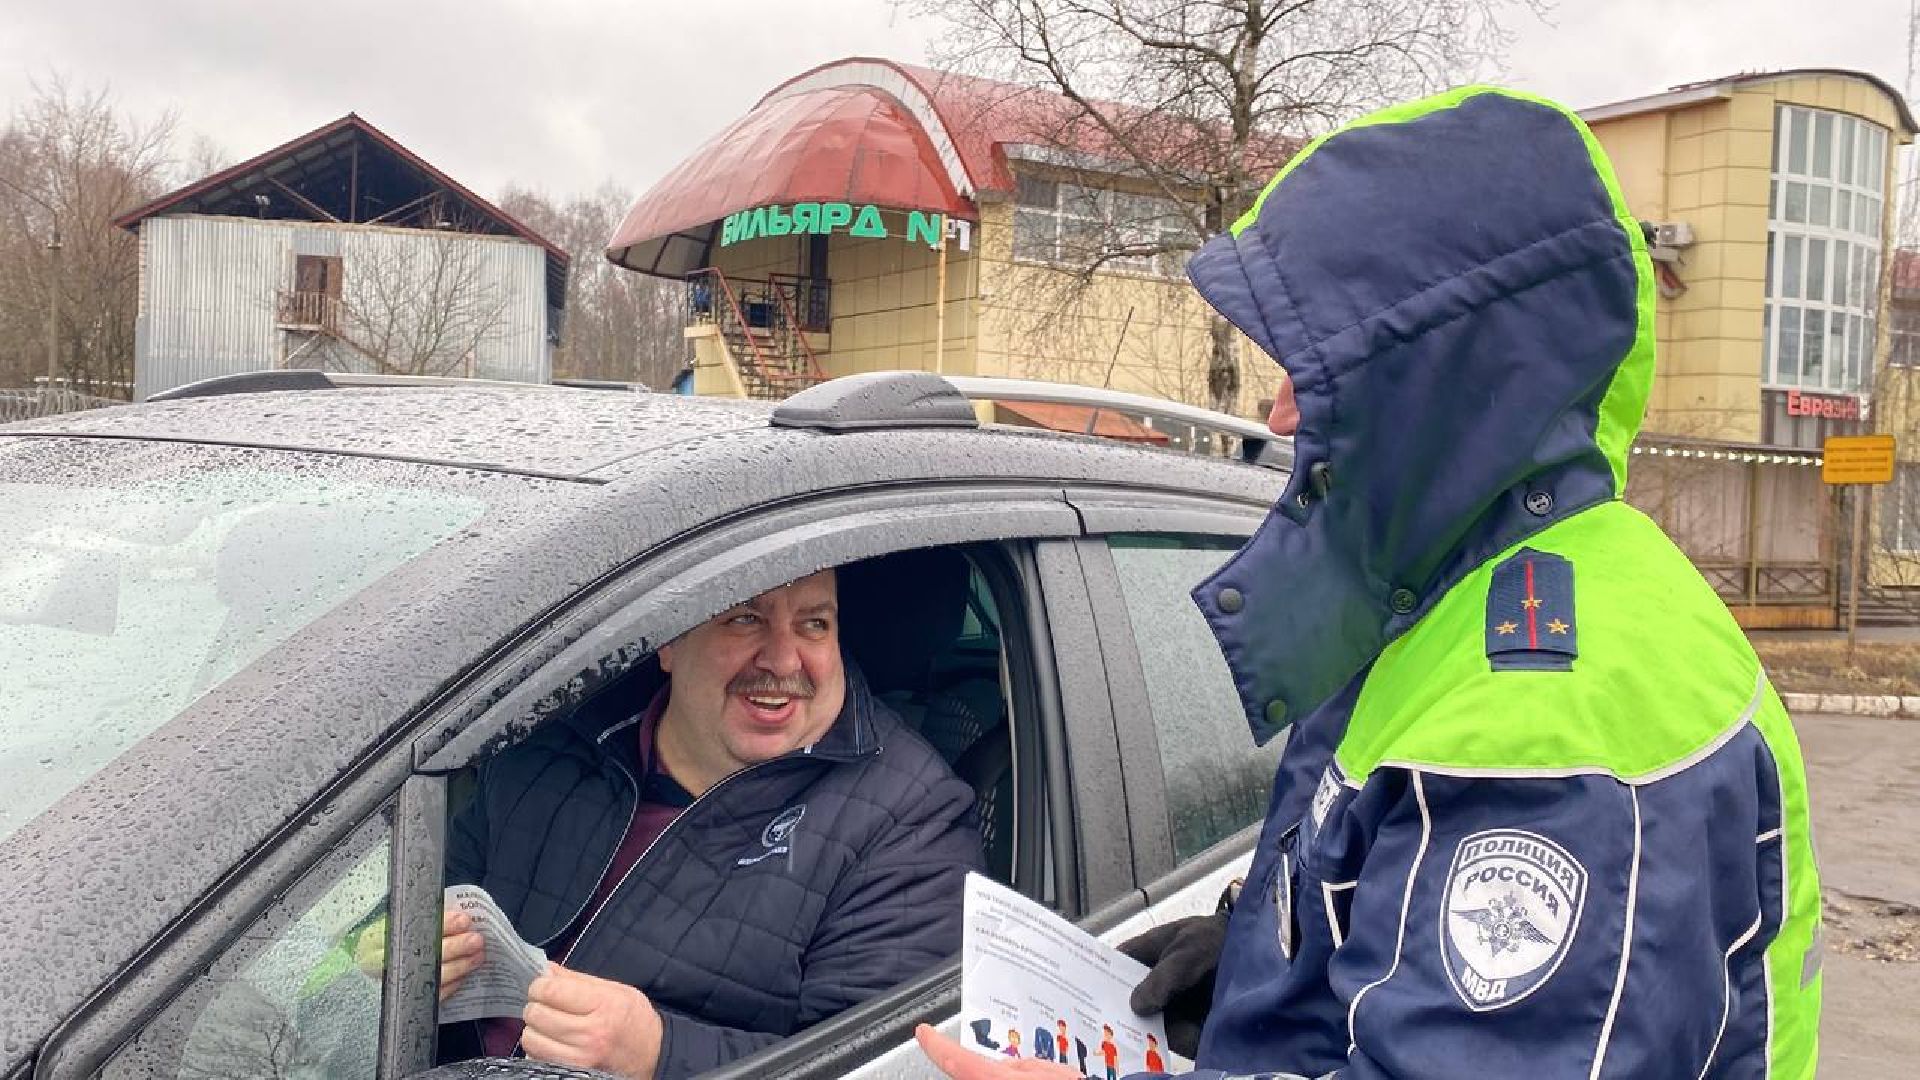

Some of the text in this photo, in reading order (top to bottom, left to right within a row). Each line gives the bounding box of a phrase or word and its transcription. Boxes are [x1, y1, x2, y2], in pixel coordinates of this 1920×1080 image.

[720, 202, 888, 248] БИЛЬЯРД
[1463, 839, 1576, 892] ПОЛИЦИЯ
[1464, 866, 1560, 920] РОССИЯ
[1461, 965, 1508, 1001] МВД
